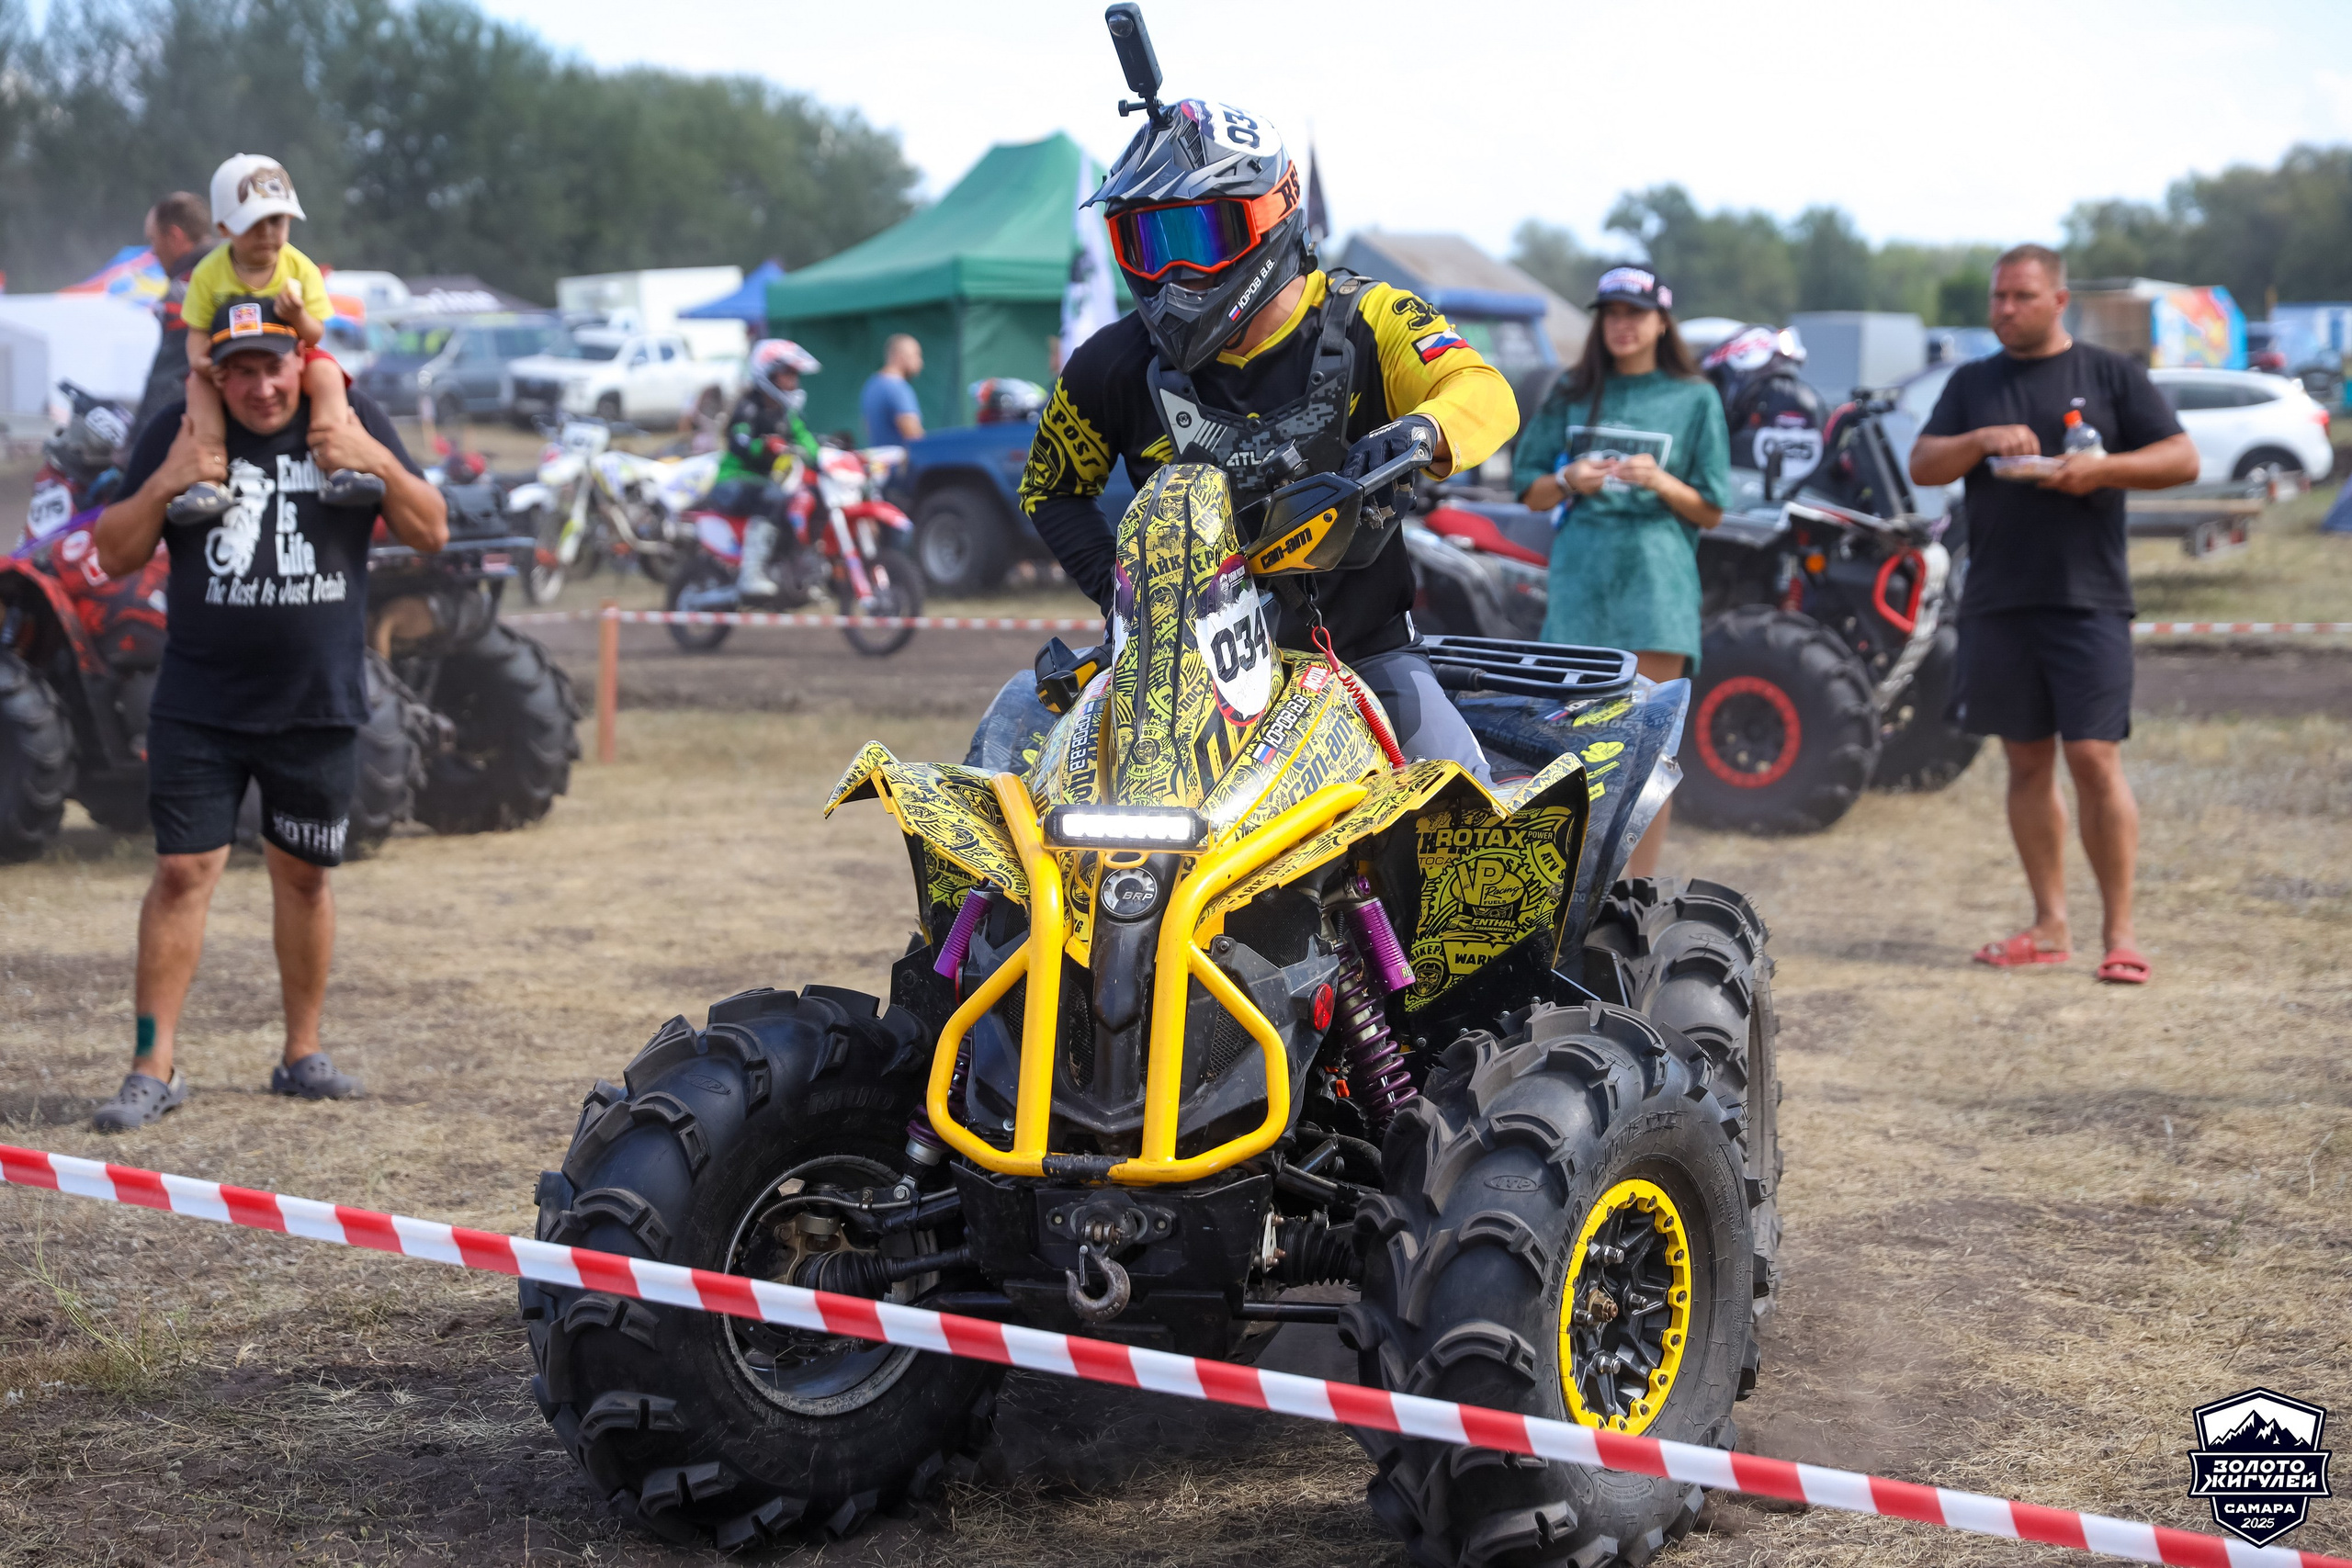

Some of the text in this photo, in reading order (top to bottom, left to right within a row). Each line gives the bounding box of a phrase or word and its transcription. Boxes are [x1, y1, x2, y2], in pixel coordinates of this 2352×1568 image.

[1237, 277, 1262, 310] ЮРОВ
[277, 492, 299, 534] Is
[276, 531, 316, 577] Life
[205, 570, 347, 607] The Rest Is Just Details
[1211, 606, 1269, 683] 034
[1436, 828, 1554, 848] ROTAX POWER
[1541, 852, 1560, 873] ATV
[1122, 890, 1154, 902] BRP
[1456, 858, 1505, 906] VP
[1484, 883, 1525, 899] Racing
